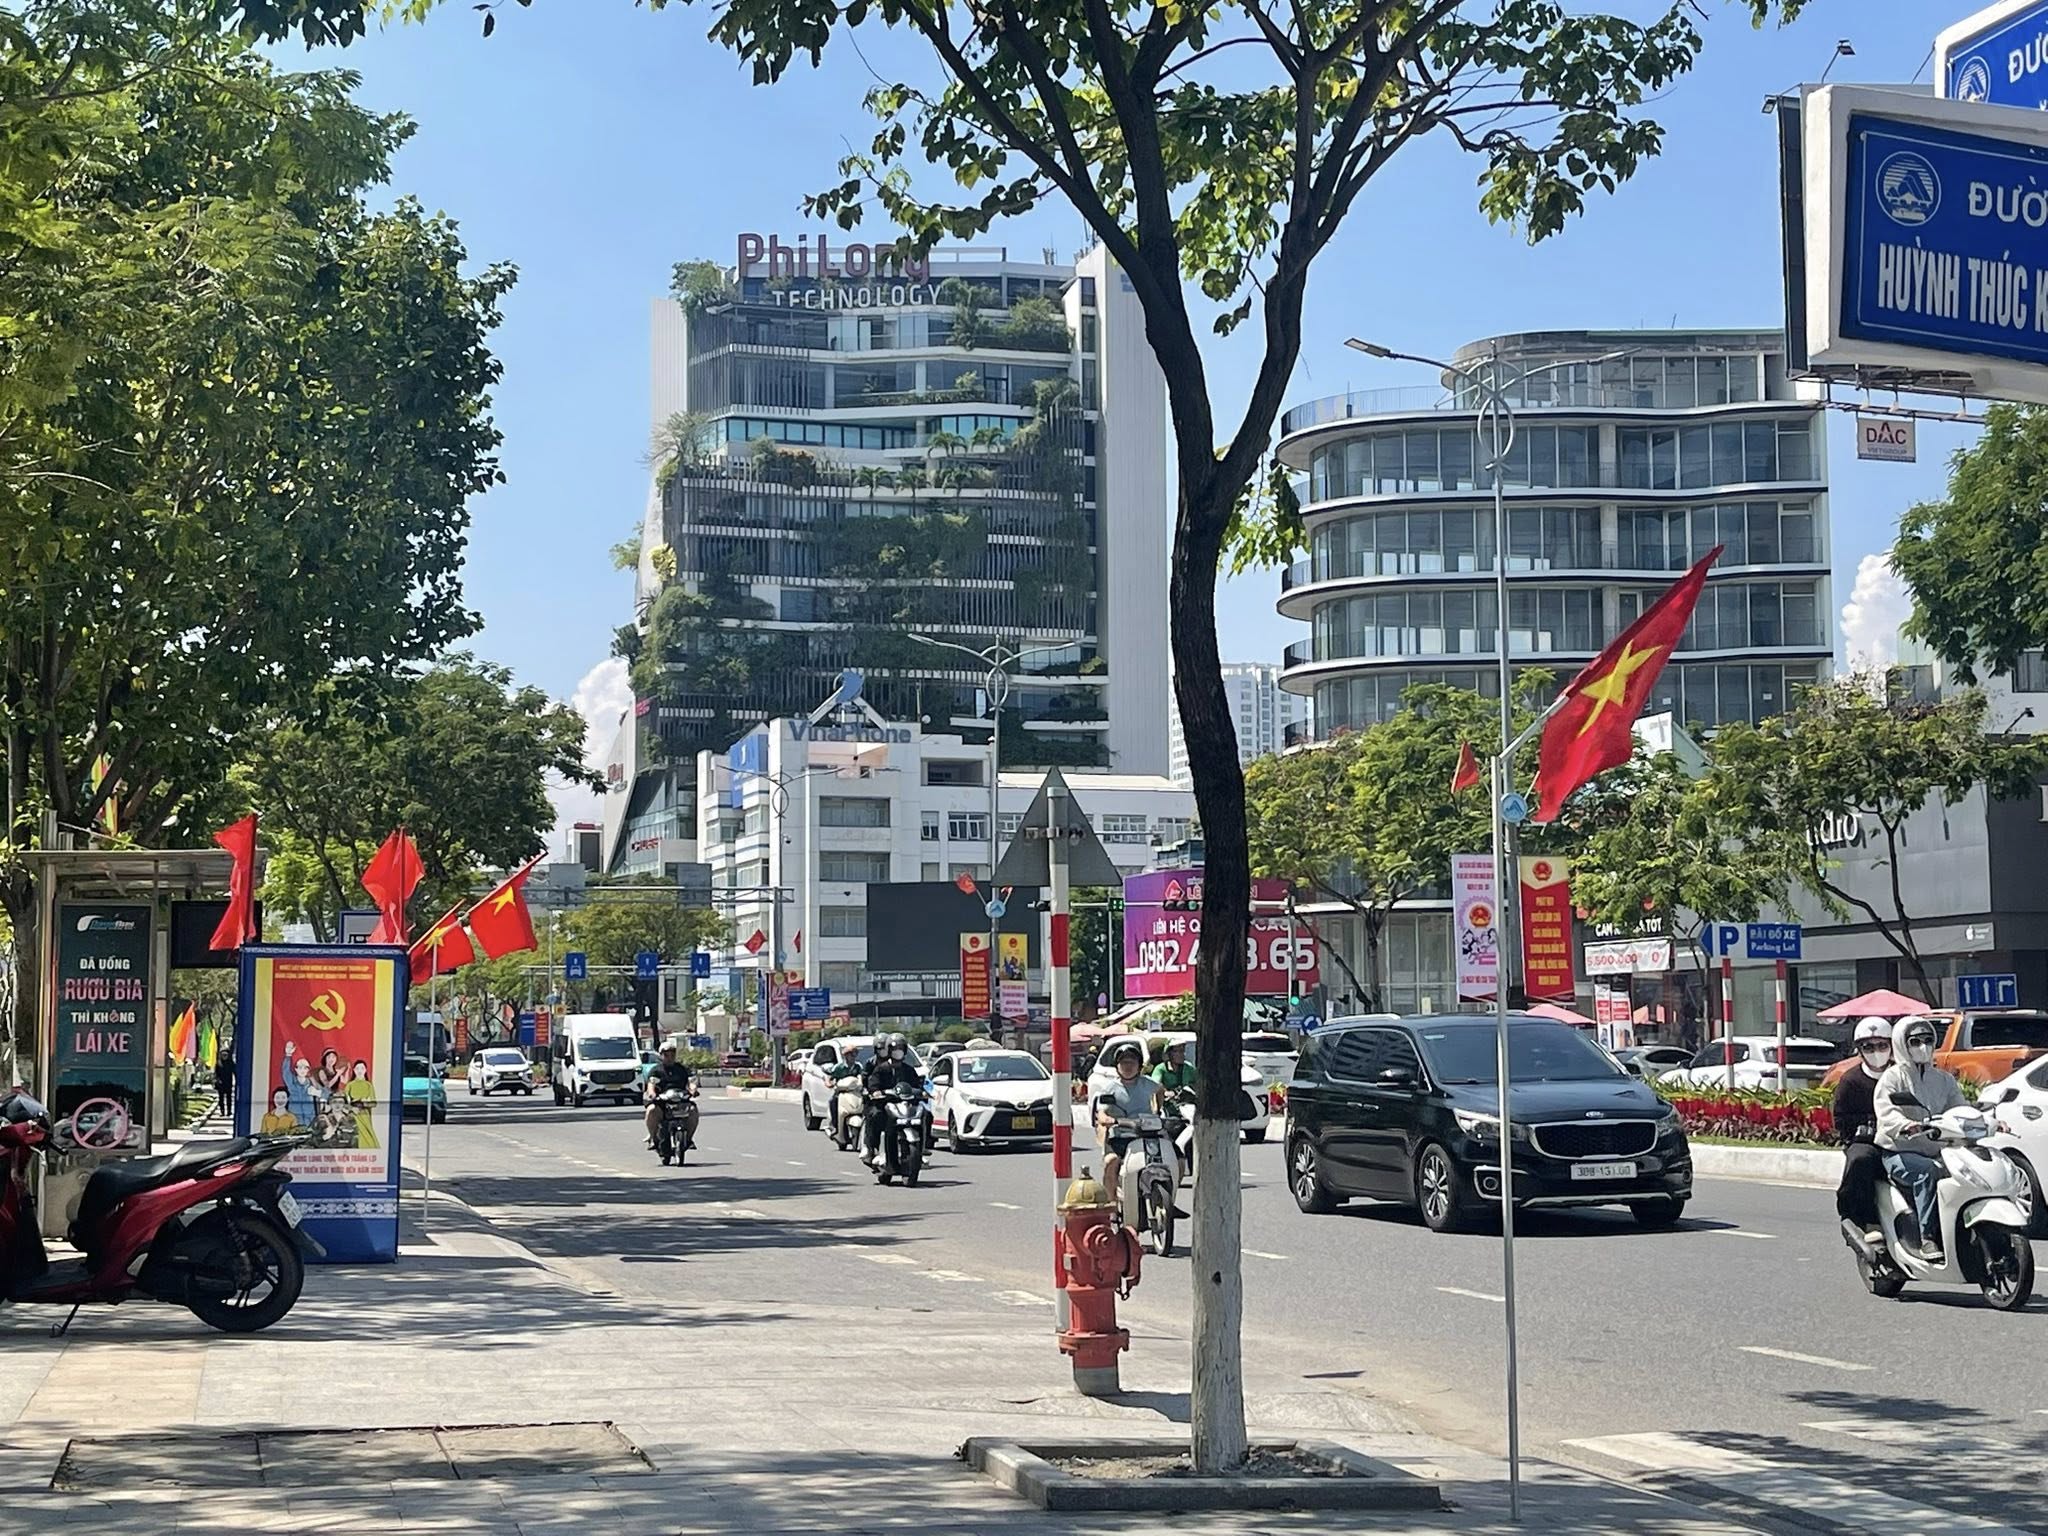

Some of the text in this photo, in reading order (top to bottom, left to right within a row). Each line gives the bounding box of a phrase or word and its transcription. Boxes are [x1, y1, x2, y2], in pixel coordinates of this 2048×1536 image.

[738, 233, 930, 284] PhiLong
[1877, 236, 1960, 319] HUỲNH
[1968, 249, 2028, 331] THÚC
[772, 284, 942, 310] TECHNOLOGY
[1866, 422, 1907, 445] DAC
[789, 719, 912, 743] VinaPhone
[1169, 915, 1186, 936] HỆ
[1784, 929, 1797, 940] XE
[1719, 925, 1739, 956] P
[1751, 941, 1781, 954] Parking
[99, 955, 130, 970] UỐNG
[64, 977, 143, 1005] RƯỢU BIA
[71, 1009, 136, 1023] THÌ KHÔNG
[75, 1028, 130, 1053] LÁI XE
